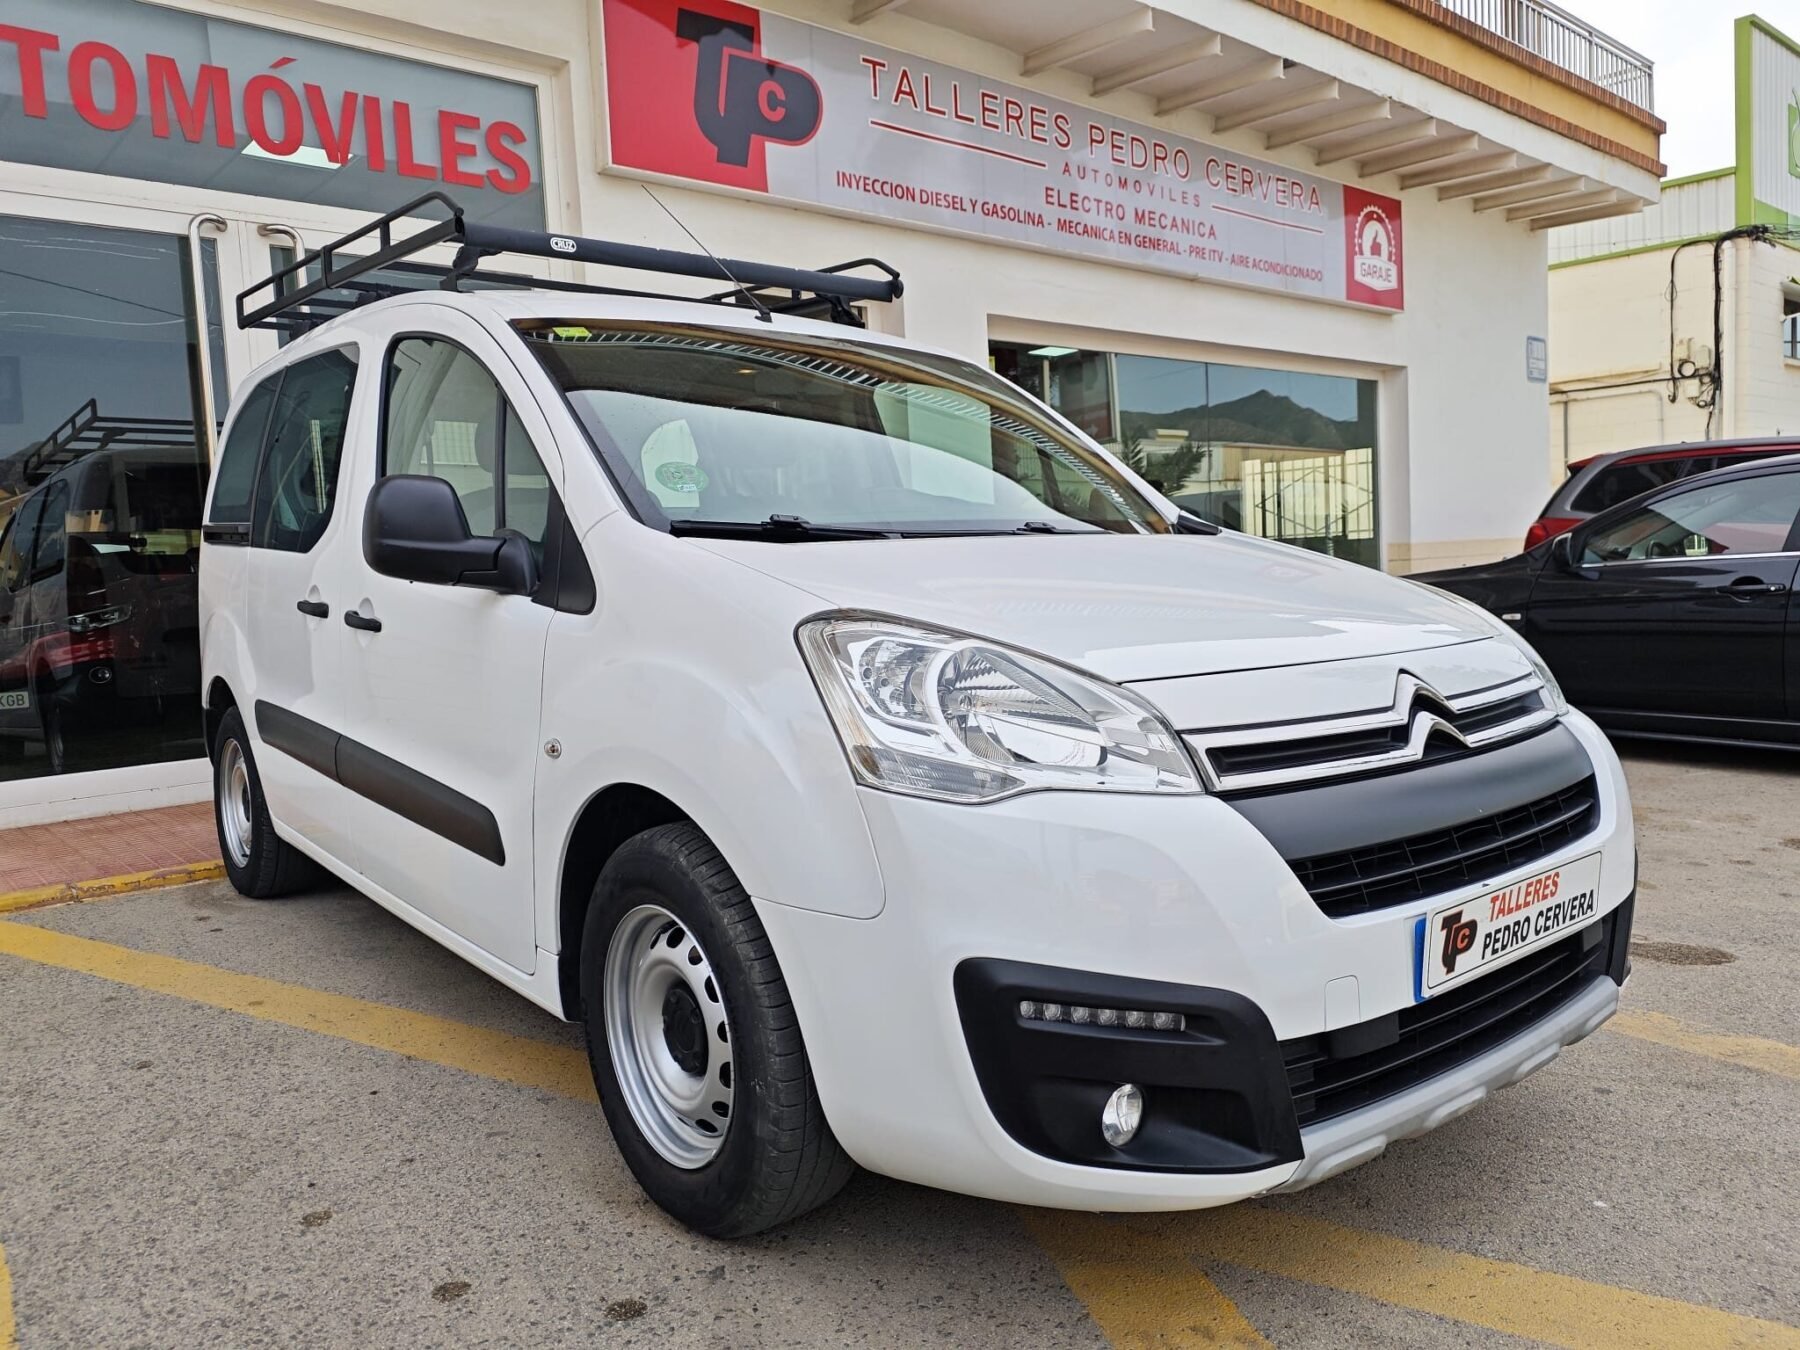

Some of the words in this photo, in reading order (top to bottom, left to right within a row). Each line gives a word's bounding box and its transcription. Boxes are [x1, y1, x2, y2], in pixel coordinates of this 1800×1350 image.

[0, 23, 532, 194] TOMÓVILES
[860, 55, 1072, 150] TALLERES
[1088, 122, 1190, 180] PEDRO
[1205, 157, 1323, 215] CERVERA
[1062, 161, 1200, 207] AUTOMOVILES
[836, 170, 916, 202] INYECCION
[919, 188, 967, 212] DIESEL
[969, 199, 978, 214] Y
[981, 201, 1045, 228] GASOLINA
[1057, 217, 1115, 243] MECANICA
[1118, 230, 1132, 246] EN
[1134, 236, 1181, 255] GENERAL
[1188, 244, 1206, 260] PRE
[1208, 249, 1224, 264] ITV
[1230, 254, 1250, 269] AIRE
[1251, 257, 1323, 282] ACONDICIONADO
[1045, 186, 1125, 221] ELECTRO
[1134, 207, 1217, 241] MECANICA
[552, 239, 575, 250] CRUZ
[1360, 261, 1392, 284] GARAJE
[1481, 917, 1530, 961] PEDRO
[1533, 888, 1595, 937] CERVERA
[1488, 871, 1560, 923] TALLERES
